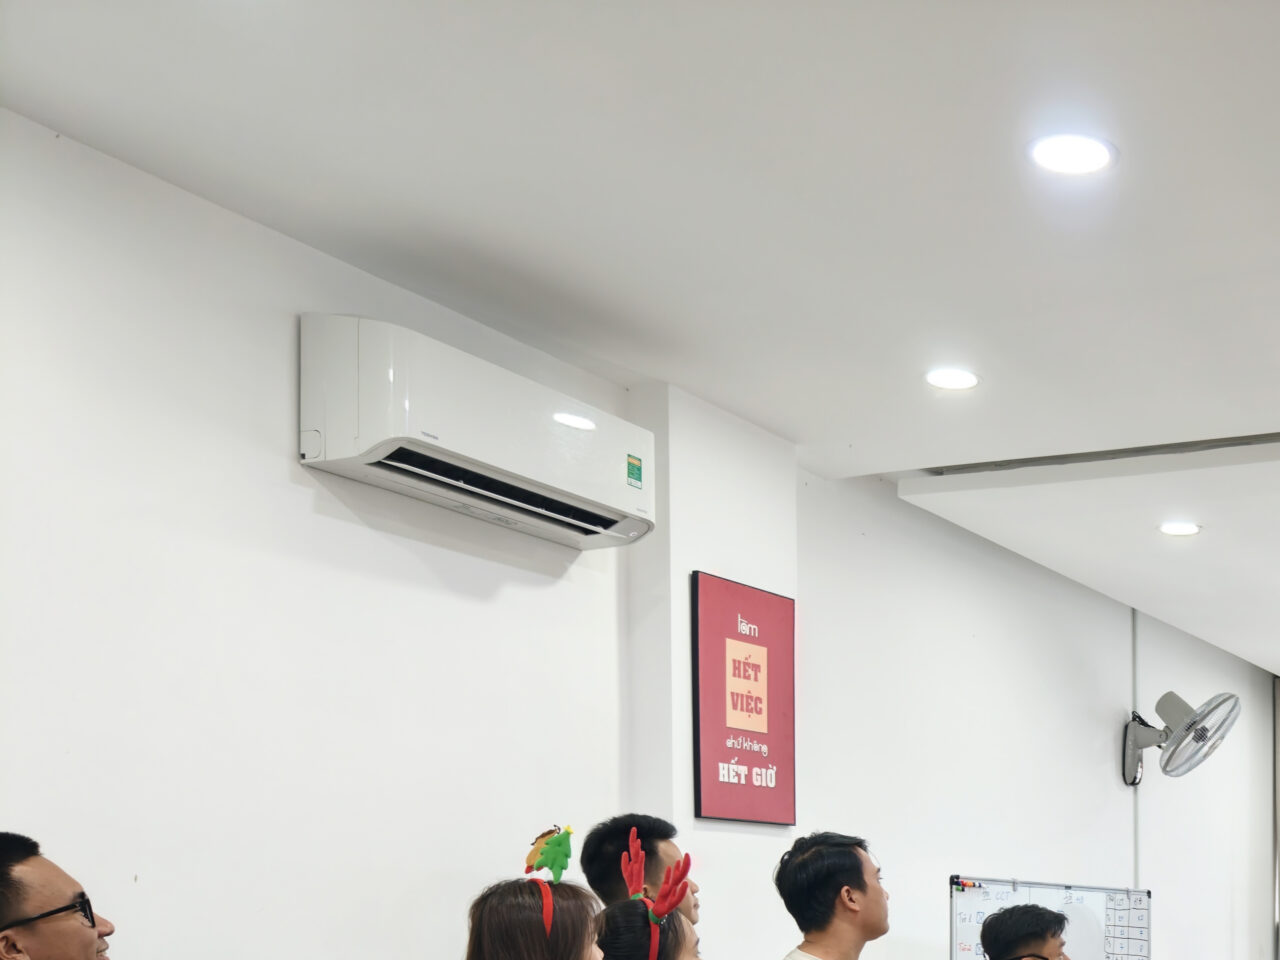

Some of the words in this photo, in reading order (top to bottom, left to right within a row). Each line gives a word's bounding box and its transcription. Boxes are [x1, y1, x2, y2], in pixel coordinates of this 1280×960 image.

[731, 654, 761, 682] HẾT
[730, 690, 763, 718] VIỆC
[718, 756, 748, 785] HẾT
[752, 763, 777, 788] GIỜ
